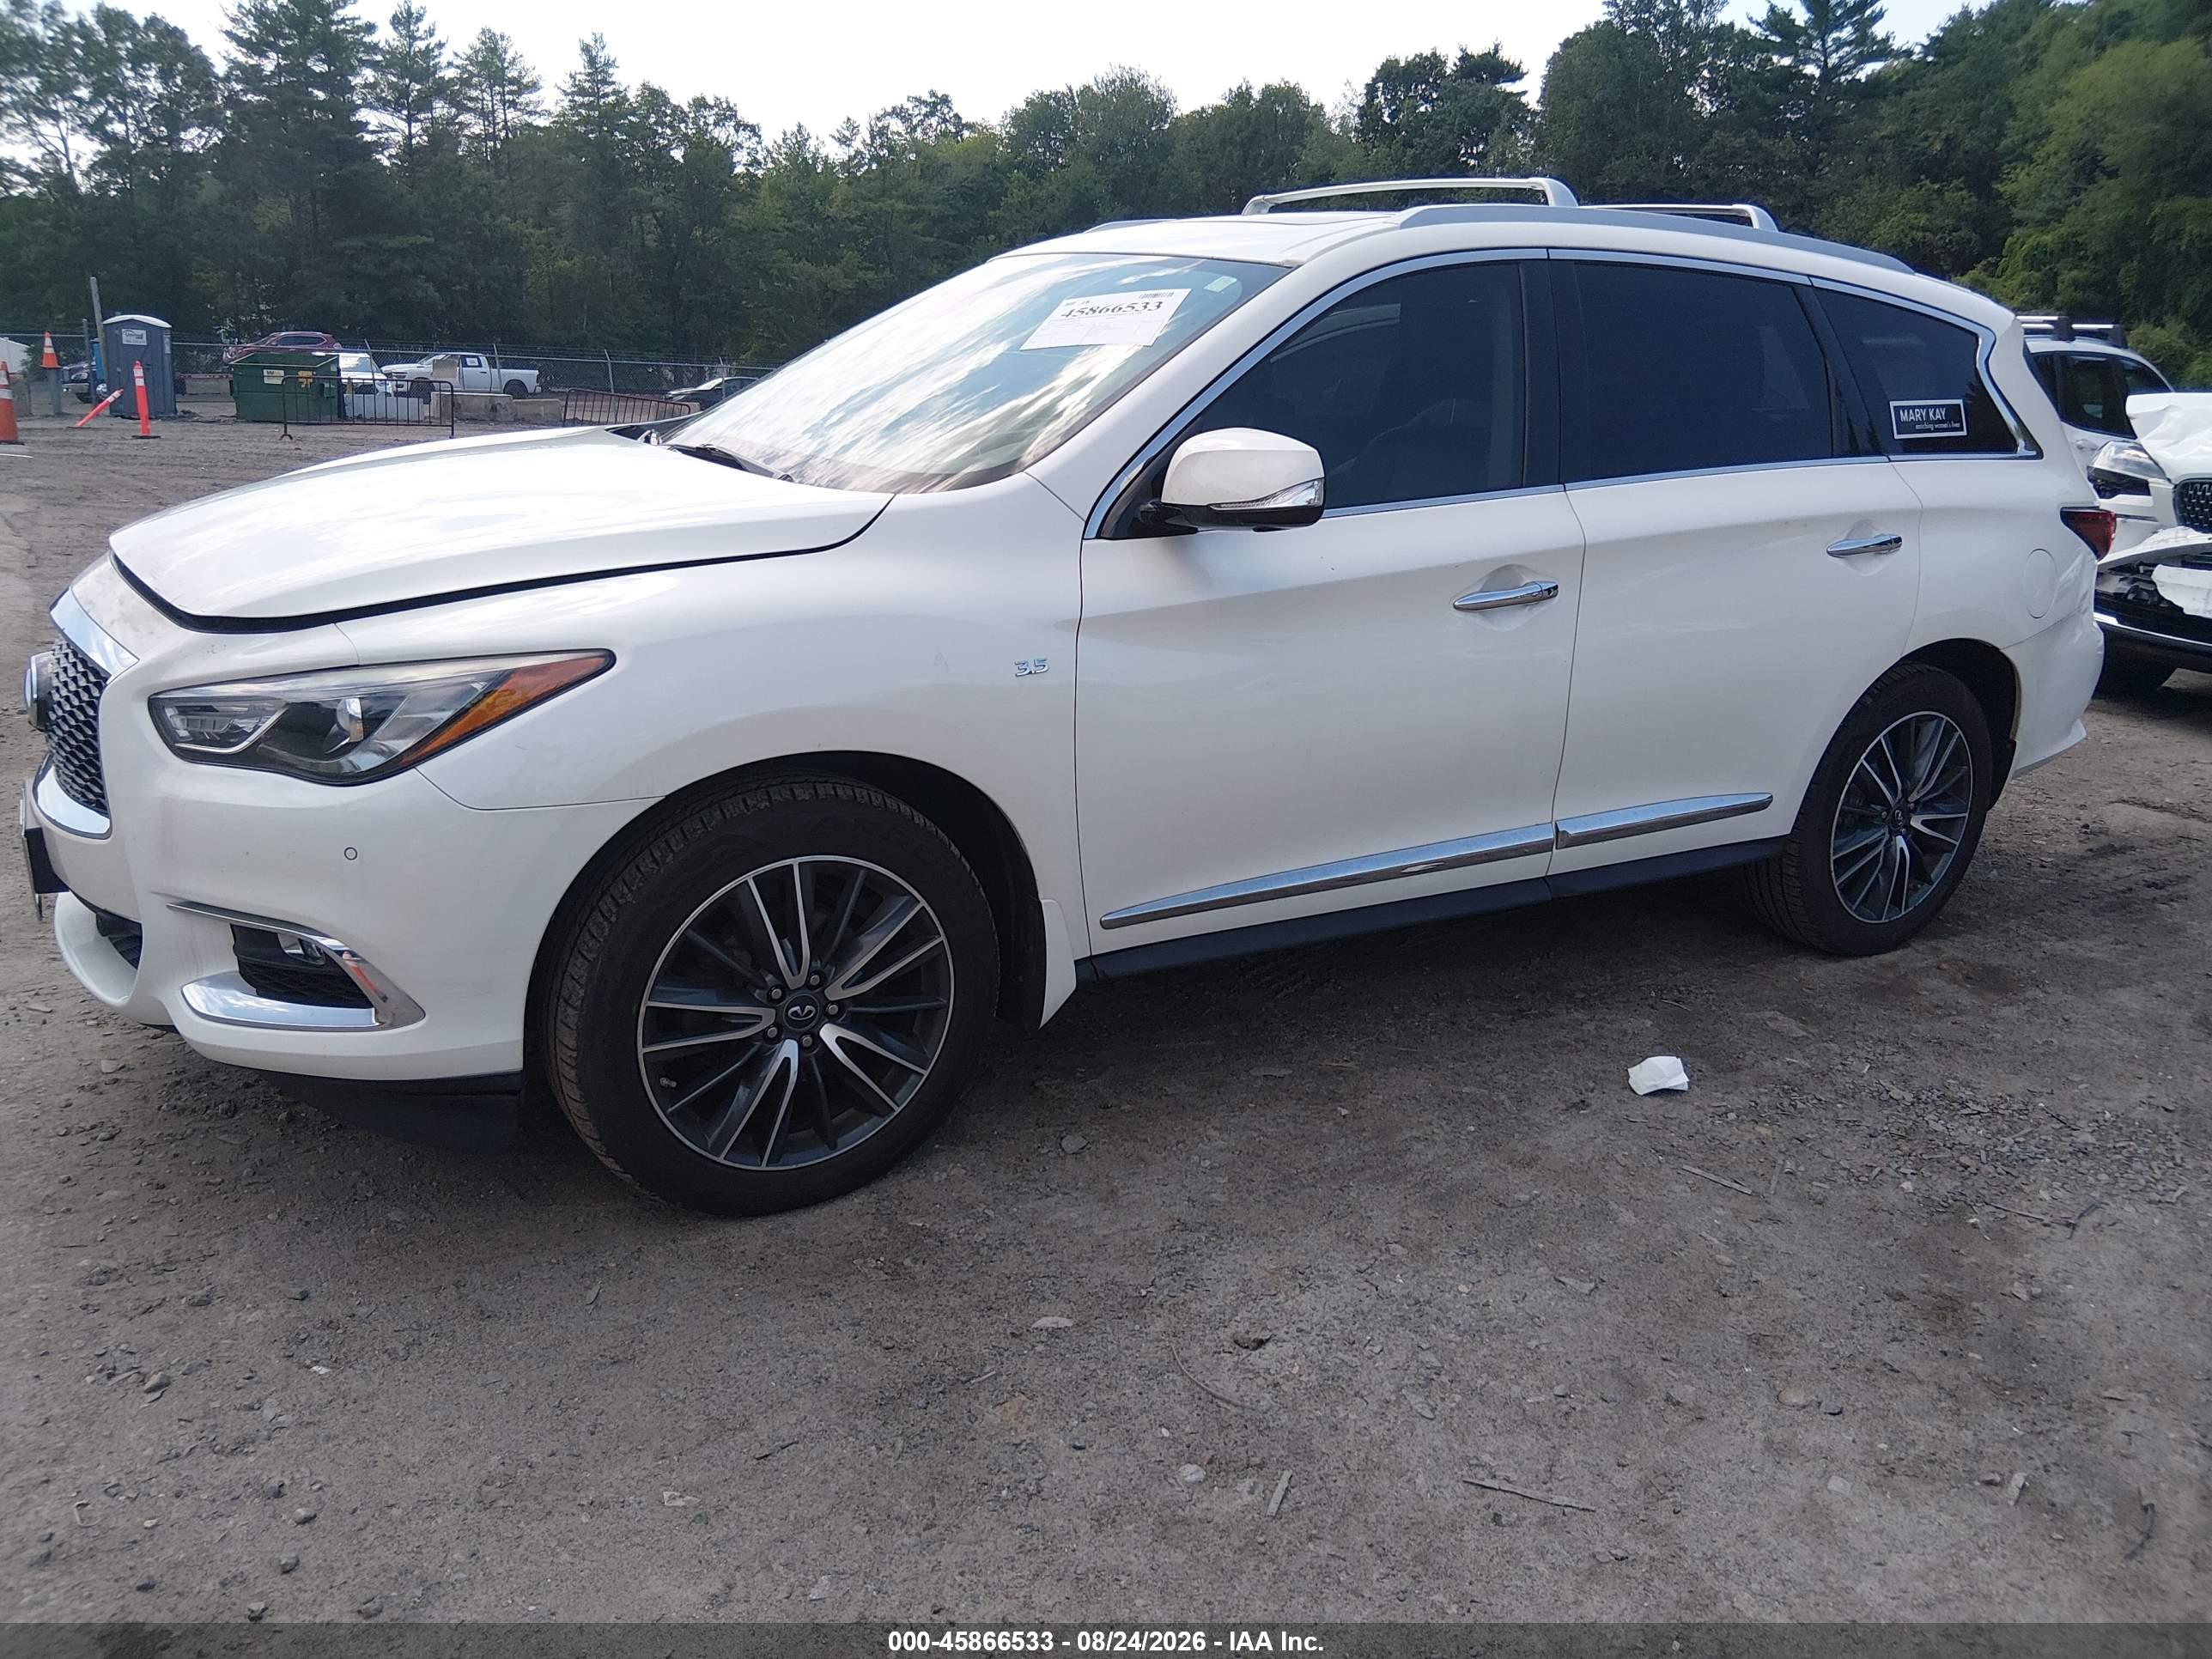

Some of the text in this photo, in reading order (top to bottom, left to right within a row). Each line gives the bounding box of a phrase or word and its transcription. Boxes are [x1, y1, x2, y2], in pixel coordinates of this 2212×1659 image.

[1060, 301, 1163, 318] 45866533
[1899, 408, 1946, 422] MARY KAY
[1014, 659, 1048, 677] 3.5
